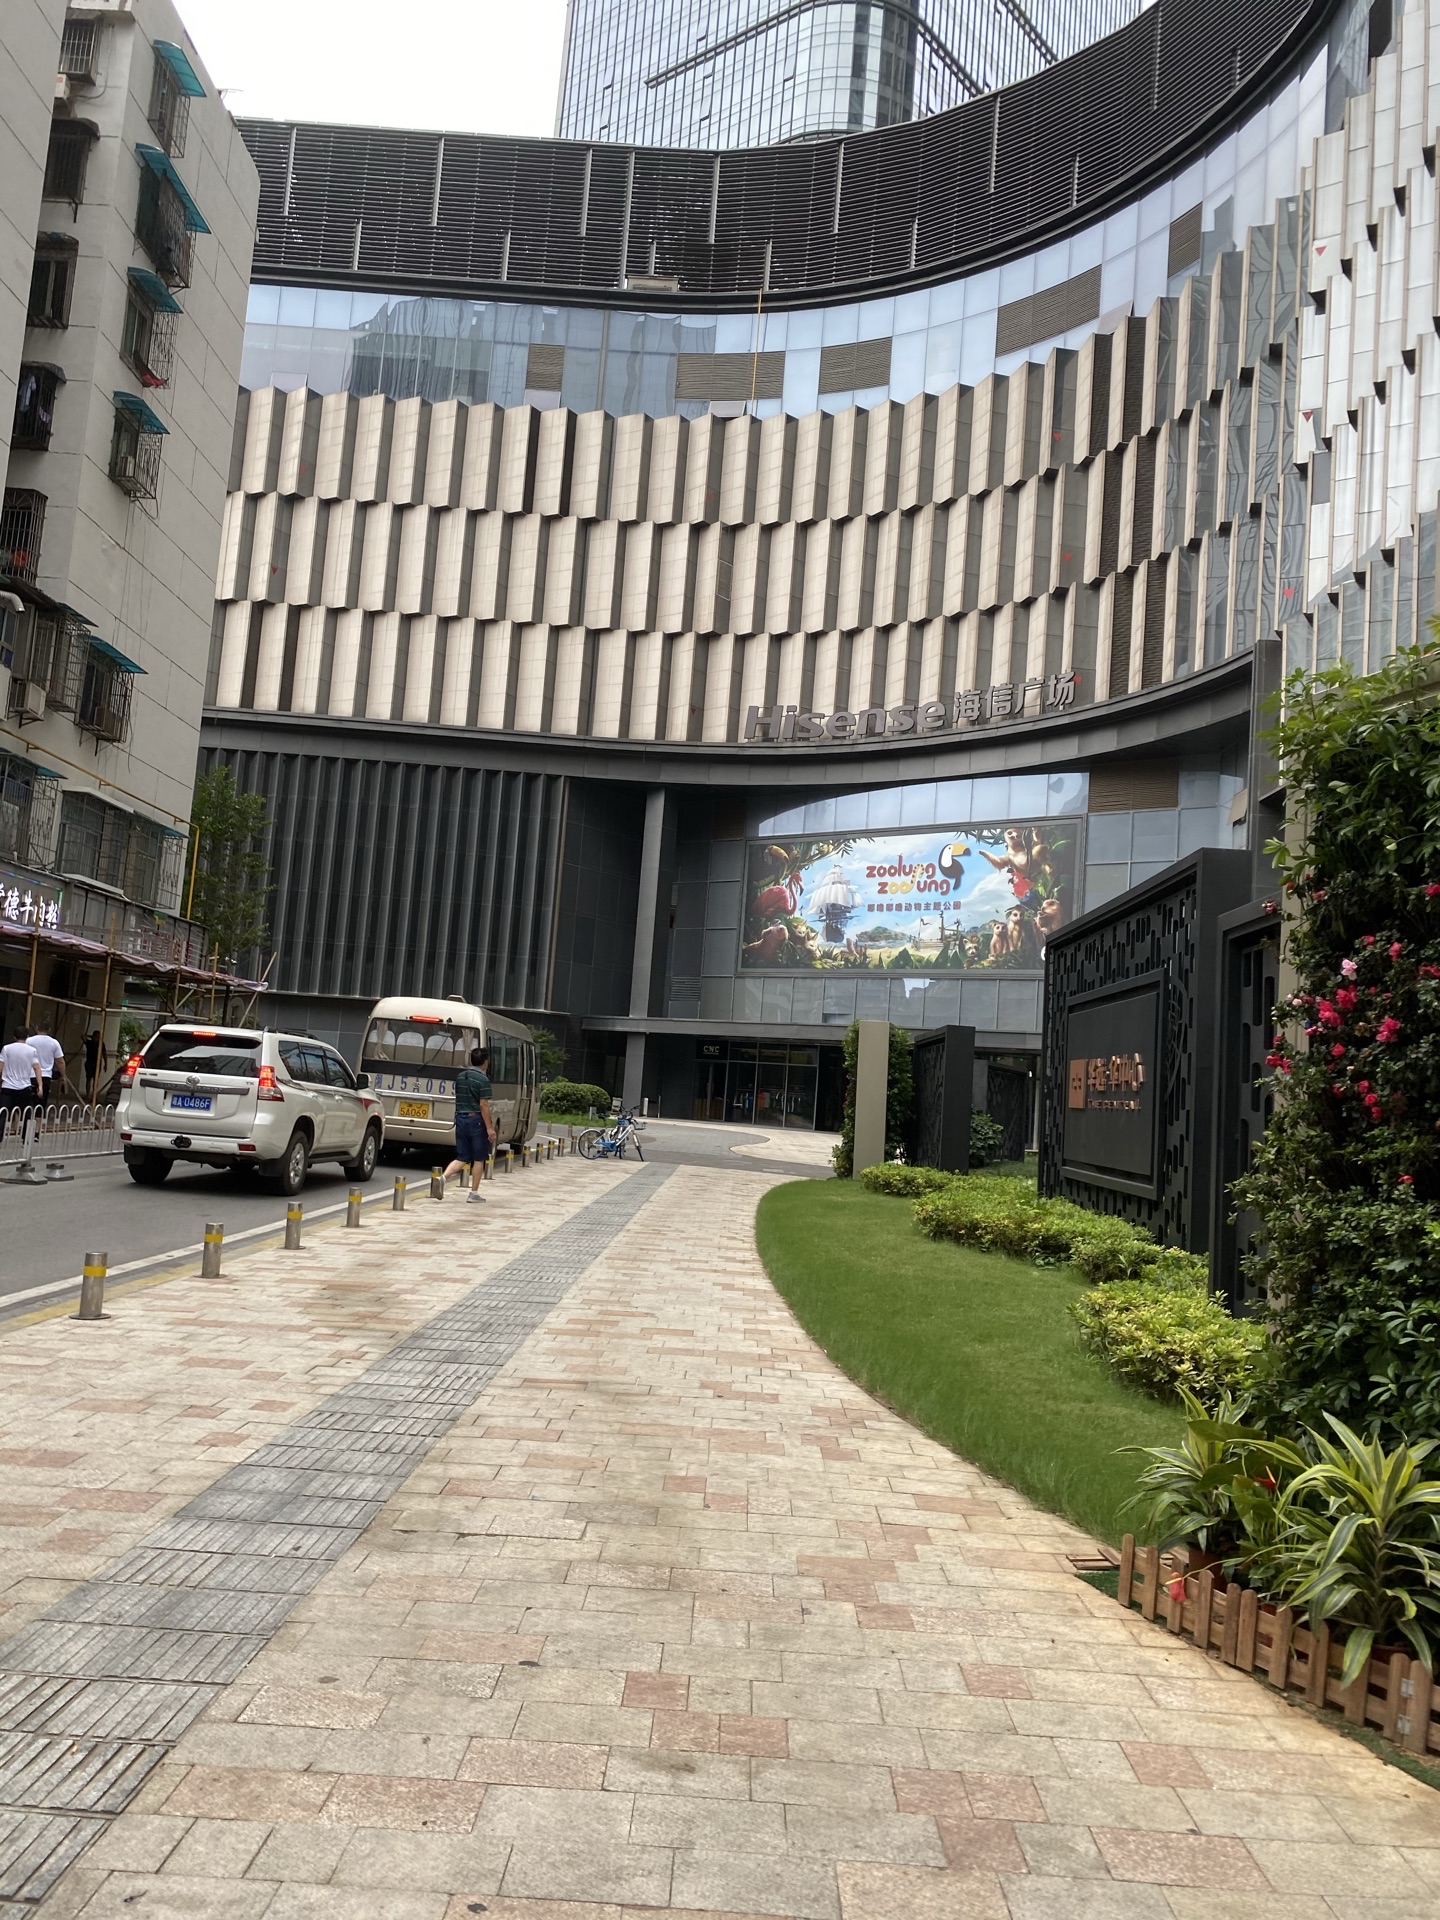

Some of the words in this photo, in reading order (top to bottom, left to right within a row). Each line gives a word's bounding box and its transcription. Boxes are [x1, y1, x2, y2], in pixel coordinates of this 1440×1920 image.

[744, 700, 946, 740] Hisense
[952, 671, 1076, 723] 海信广场
[400, 1107, 427, 1117] 5A069
